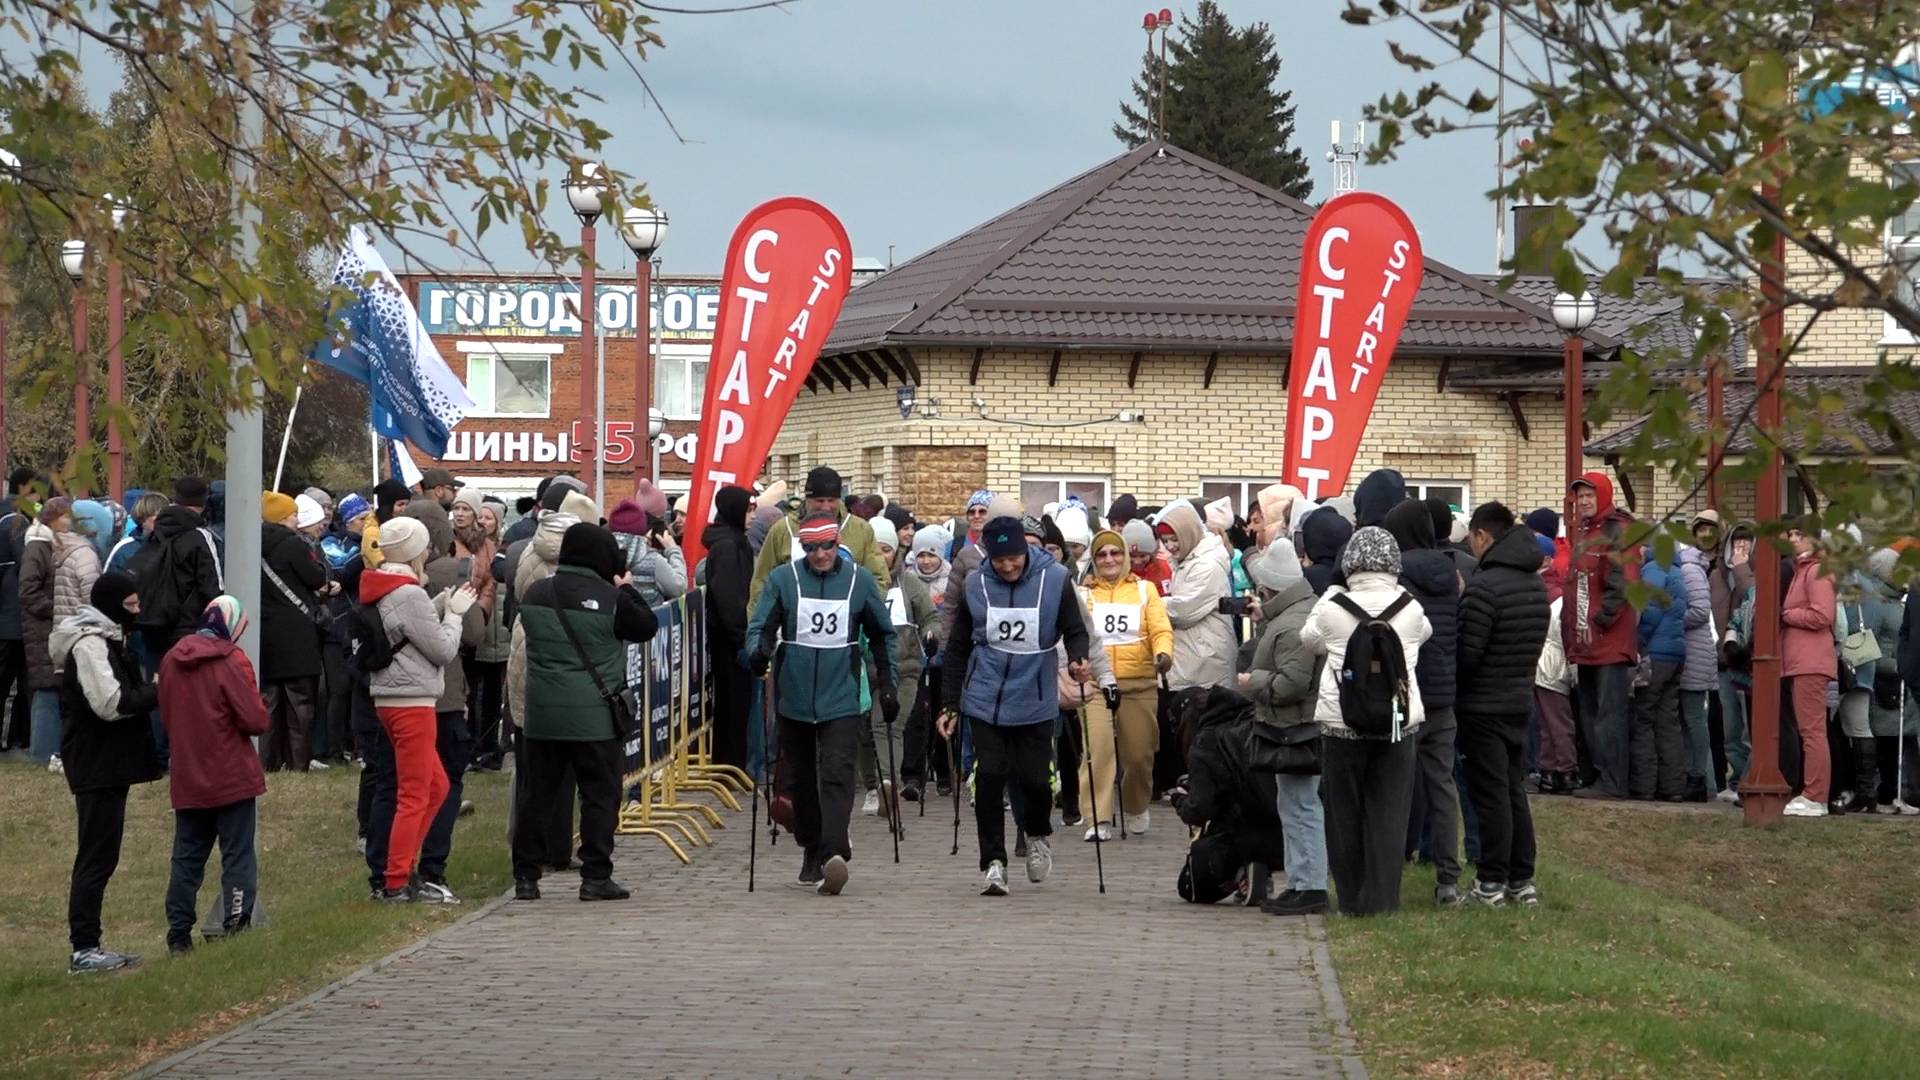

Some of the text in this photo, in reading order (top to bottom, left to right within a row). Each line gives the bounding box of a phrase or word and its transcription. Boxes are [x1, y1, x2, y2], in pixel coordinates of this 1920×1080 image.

[430, 289, 583, 332] ГОРОД
[764, 249, 841, 399] START
[1349, 240, 1410, 393] START
[708, 229, 779, 524] СТАРТ
[1298, 227, 1349, 500] СТАРТ
[811, 612, 838, 634] 93
[999, 620, 1026, 642] 92
[1104, 615, 1128, 633] 85
